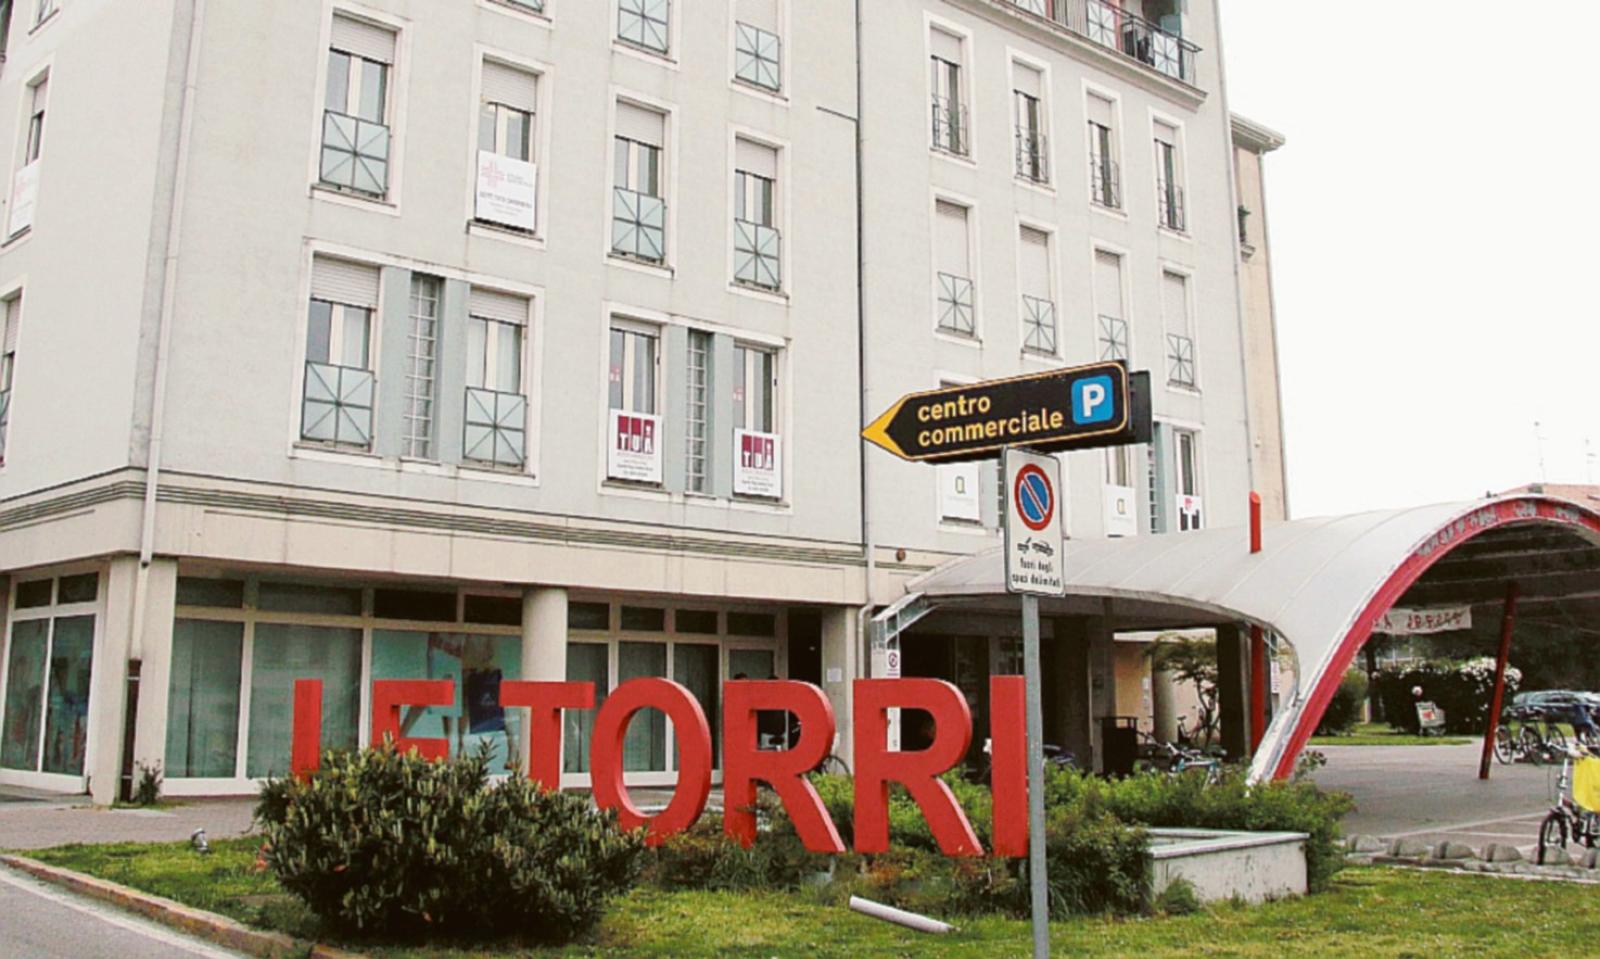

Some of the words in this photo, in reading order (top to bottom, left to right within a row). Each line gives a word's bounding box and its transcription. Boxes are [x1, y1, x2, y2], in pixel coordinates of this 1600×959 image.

[918, 395, 991, 423] centro
[1082, 383, 1105, 417] P
[918, 410, 1064, 447] commerciale
[500, 675, 1029, 857] TORRI
